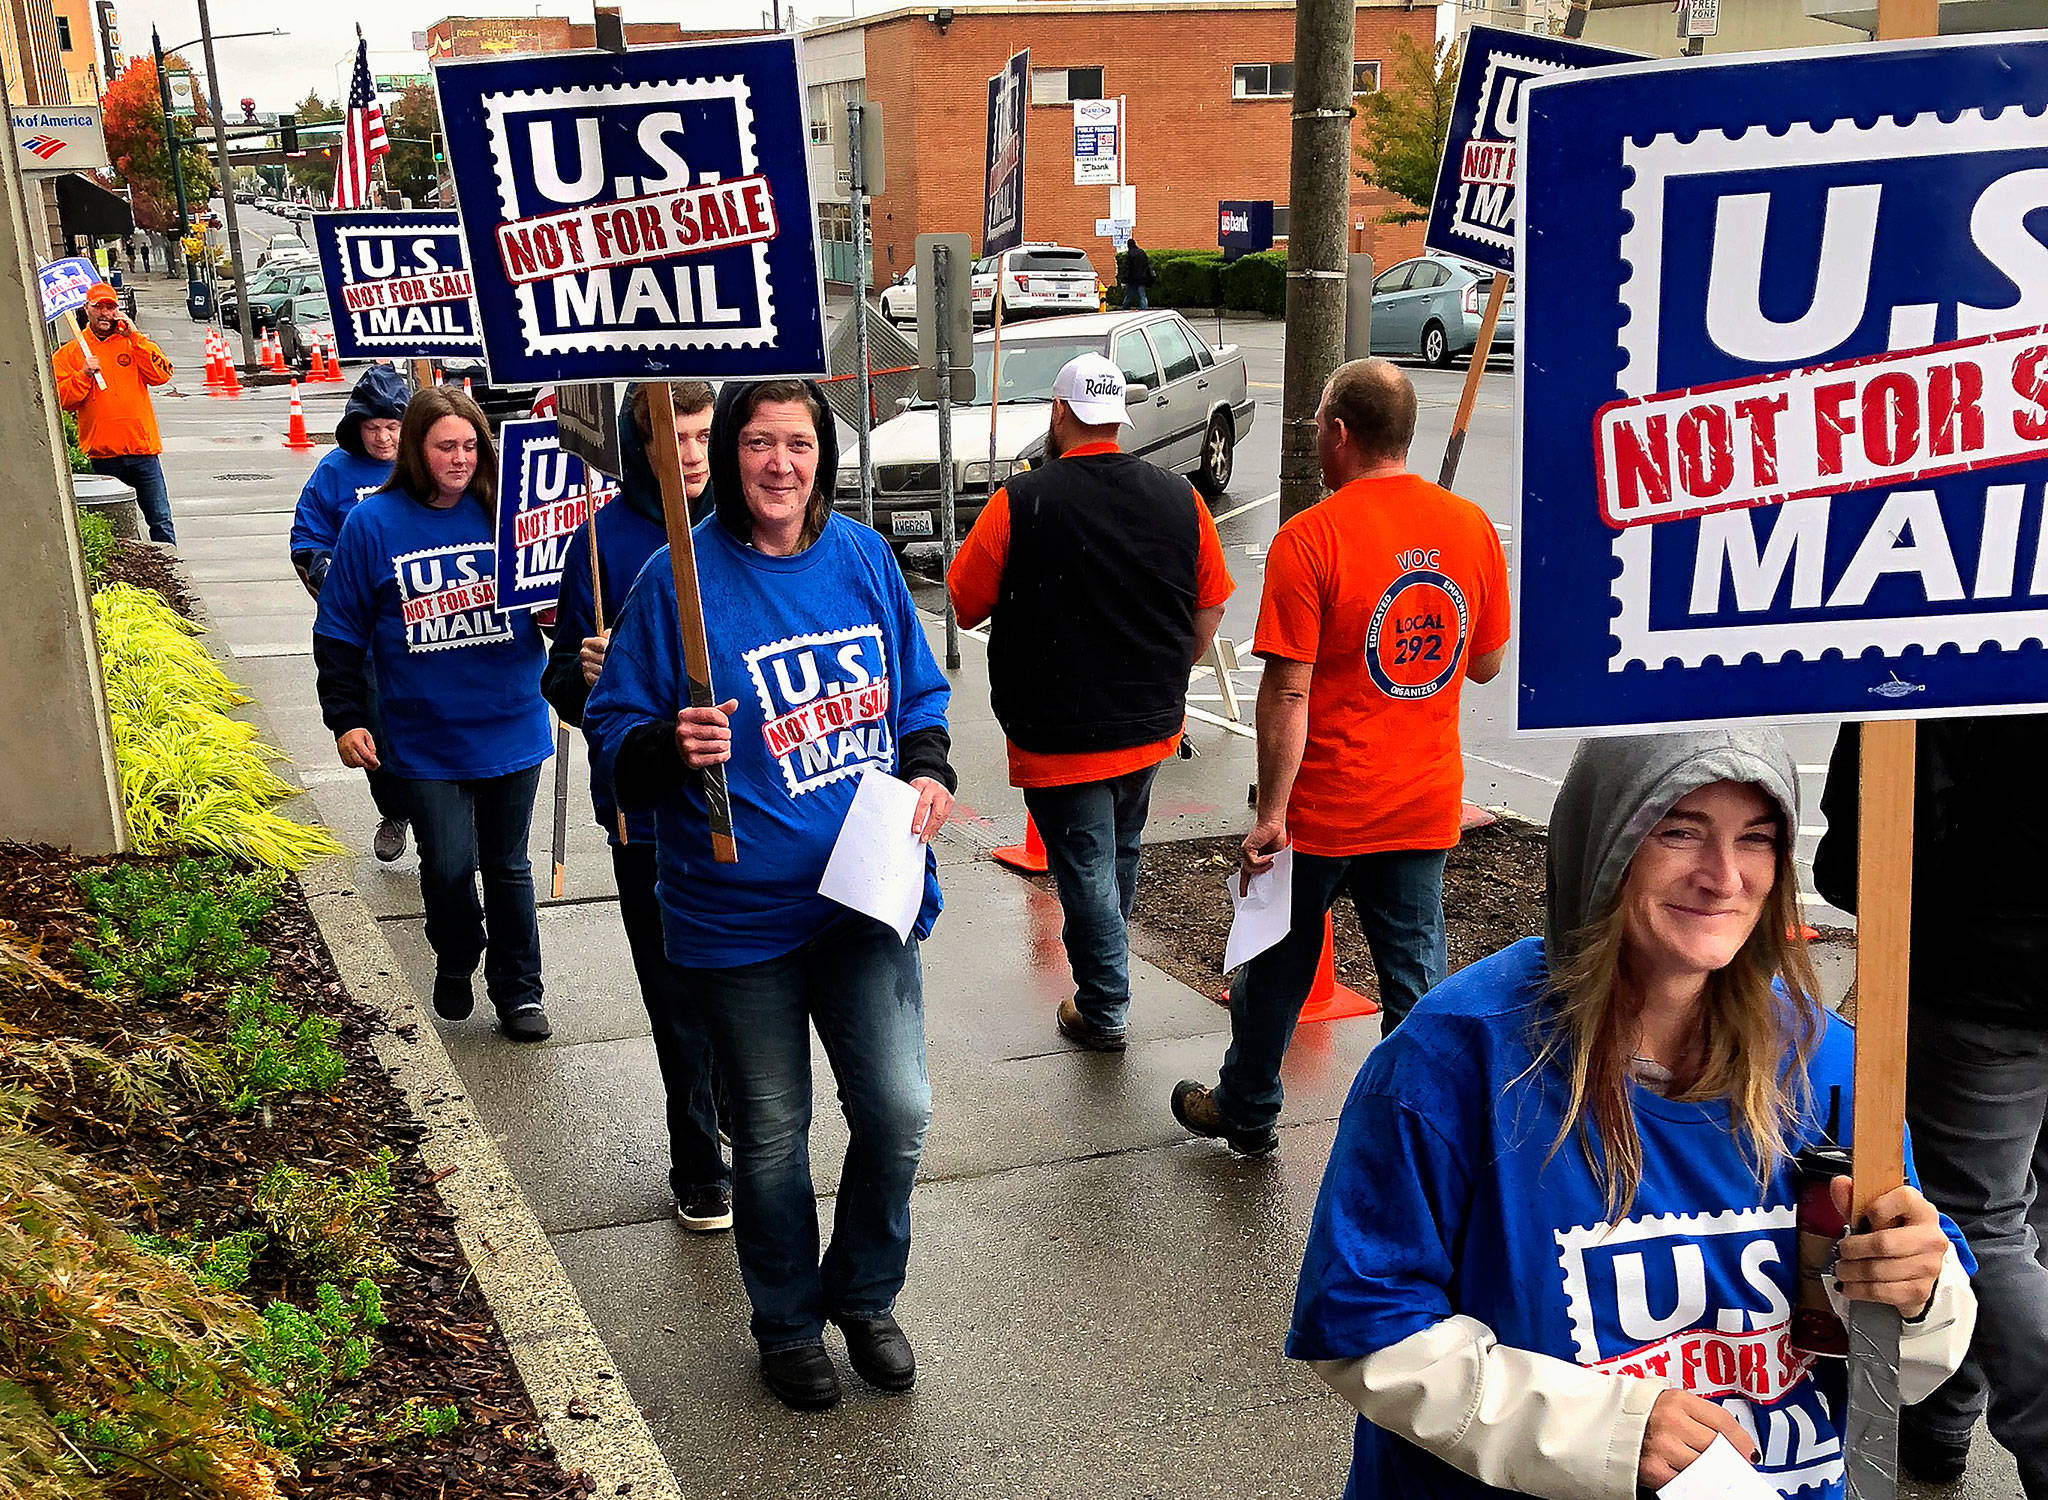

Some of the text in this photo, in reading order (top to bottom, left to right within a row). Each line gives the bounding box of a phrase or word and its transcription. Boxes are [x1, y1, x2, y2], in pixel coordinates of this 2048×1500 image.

[1691, 9, 1716, 19] ZONE
[1692, 0, 1716, 8] FREE
[40, 113, 93, 128] America
[528, 111, 721, 203] U.S.
[1463, 145, 1506, 180] NOT
[504, 184, 770, 275] NOT FOR SALE
[357, 239, 454, 278] U.S.
[345, 284, 385, 309] NOT
[388, 279, 427, 303] FOR
[552, 265, 741, 327] MAIL
[369, 306, 464, 333] MAIL
[1612, 392, 1789, 510] NOT
[1813, 361, 1987, 478] FOR
[517, 504, 587, 544] NOT FOR
[410, 555, 493, 594] U.S.
[1395, 548, 1441, 572] VOC
[404, 598, 436, 623] NOT
[438, 588, 469, 616] FOR
[1368, 594, 1392, 648] EDUCATED
[1395, 614, 1445, 634] LOCAL
[419, 610, 501, 643] MAIL
[1394, 634, 1443, 665] 292
[772, 644, 881, 705] U.S.
[768, 711, 809, 753] NOT
[813, 696, 853, 732] FOR
[1682, 1339, 1769, 1395] FOR
